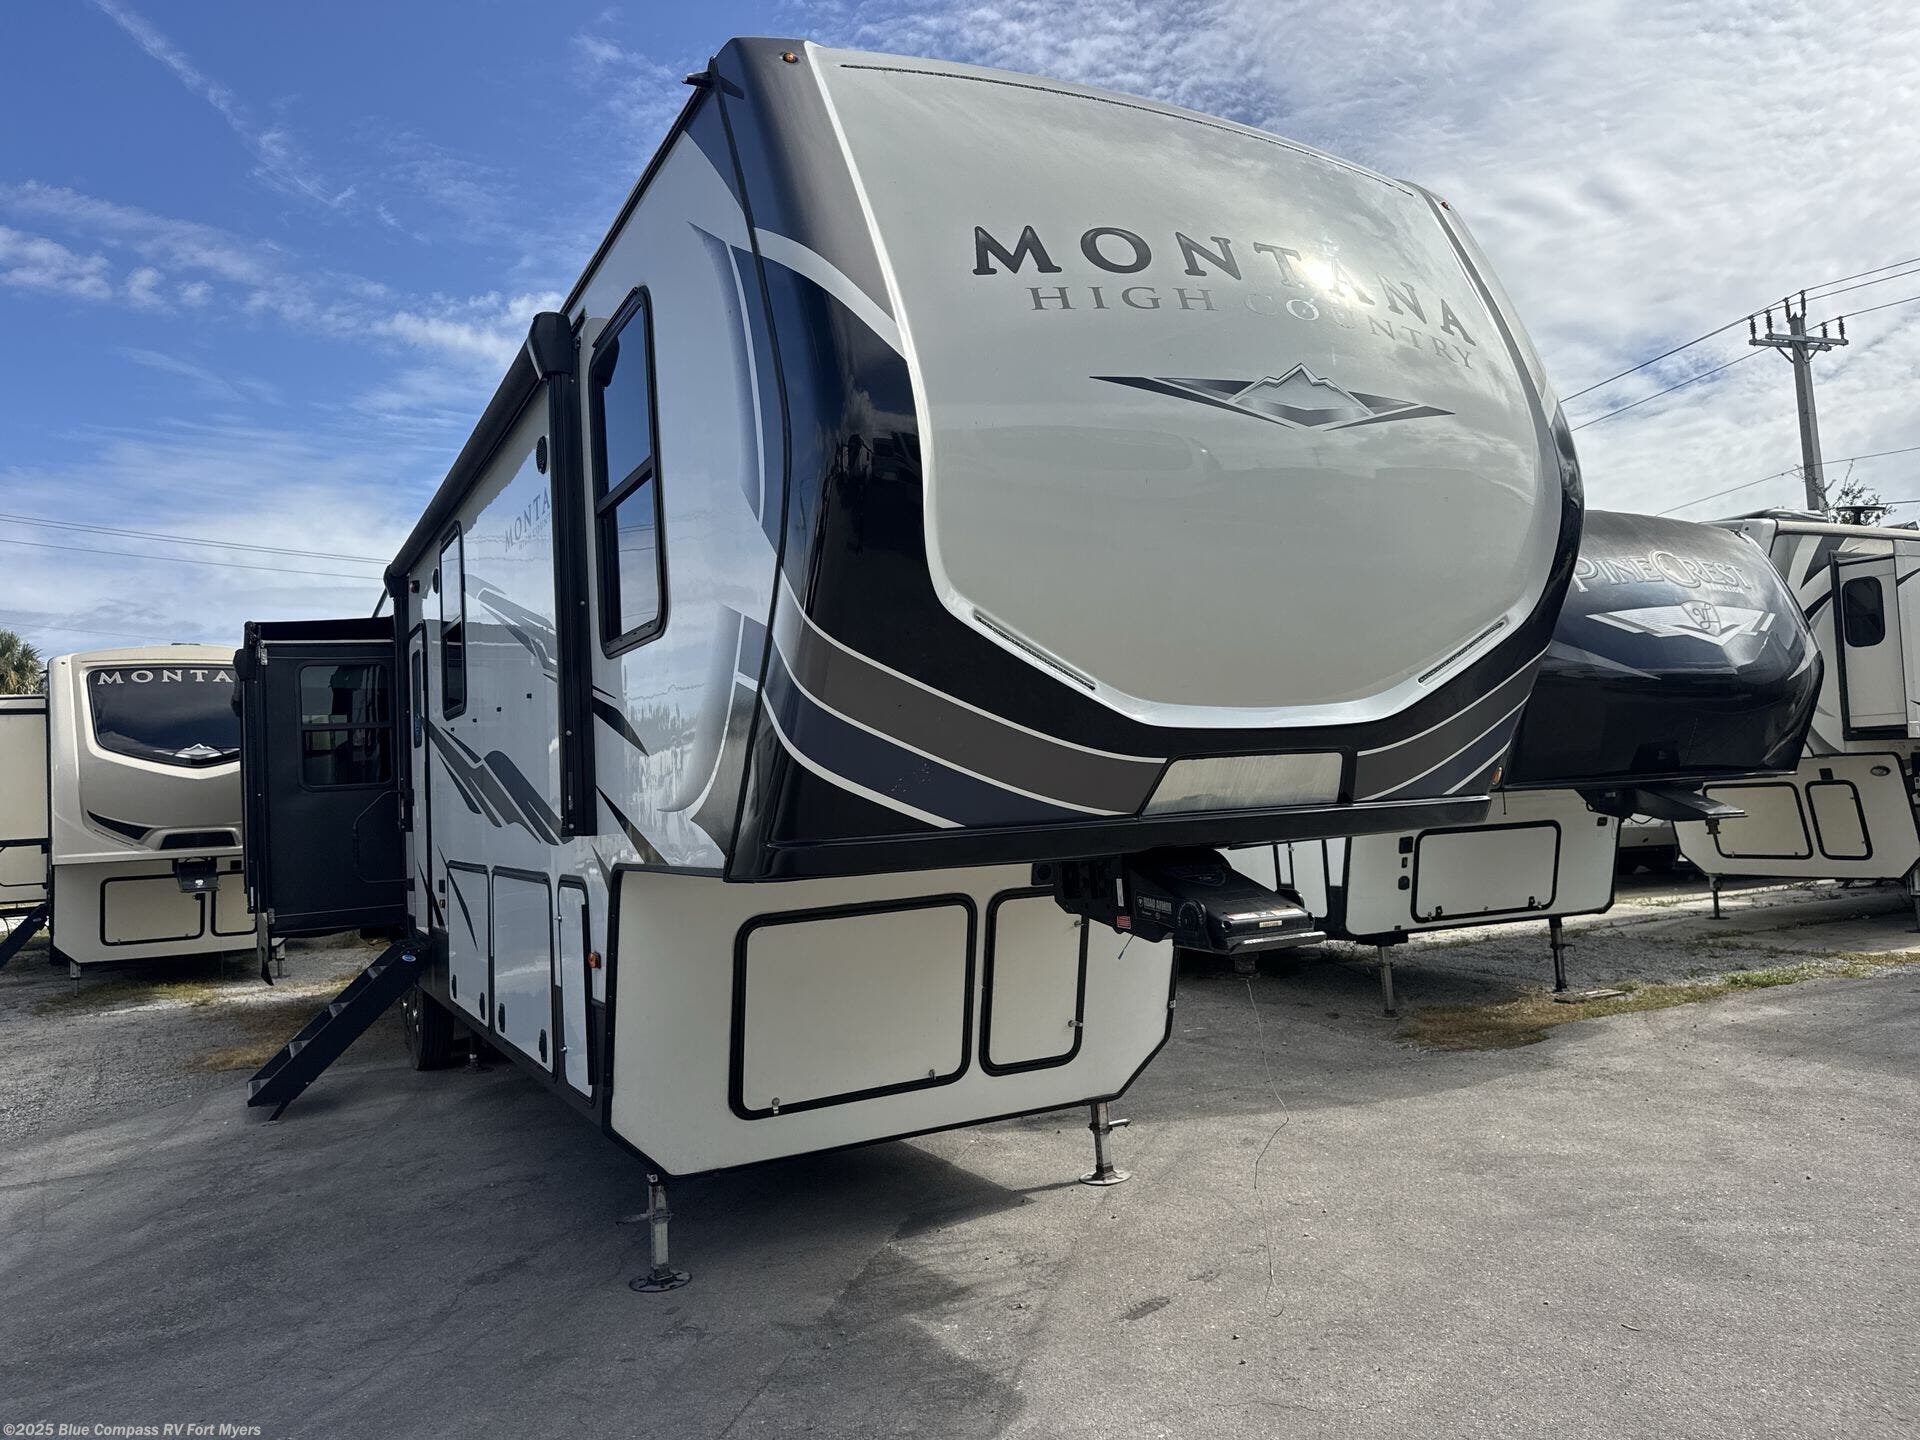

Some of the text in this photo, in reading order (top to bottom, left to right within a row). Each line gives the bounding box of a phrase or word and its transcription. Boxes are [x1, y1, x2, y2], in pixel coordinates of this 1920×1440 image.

[972, 225, 1476, 347] MONTANA
[1028, 286, 1474, 369] HIGH COUNTRY
